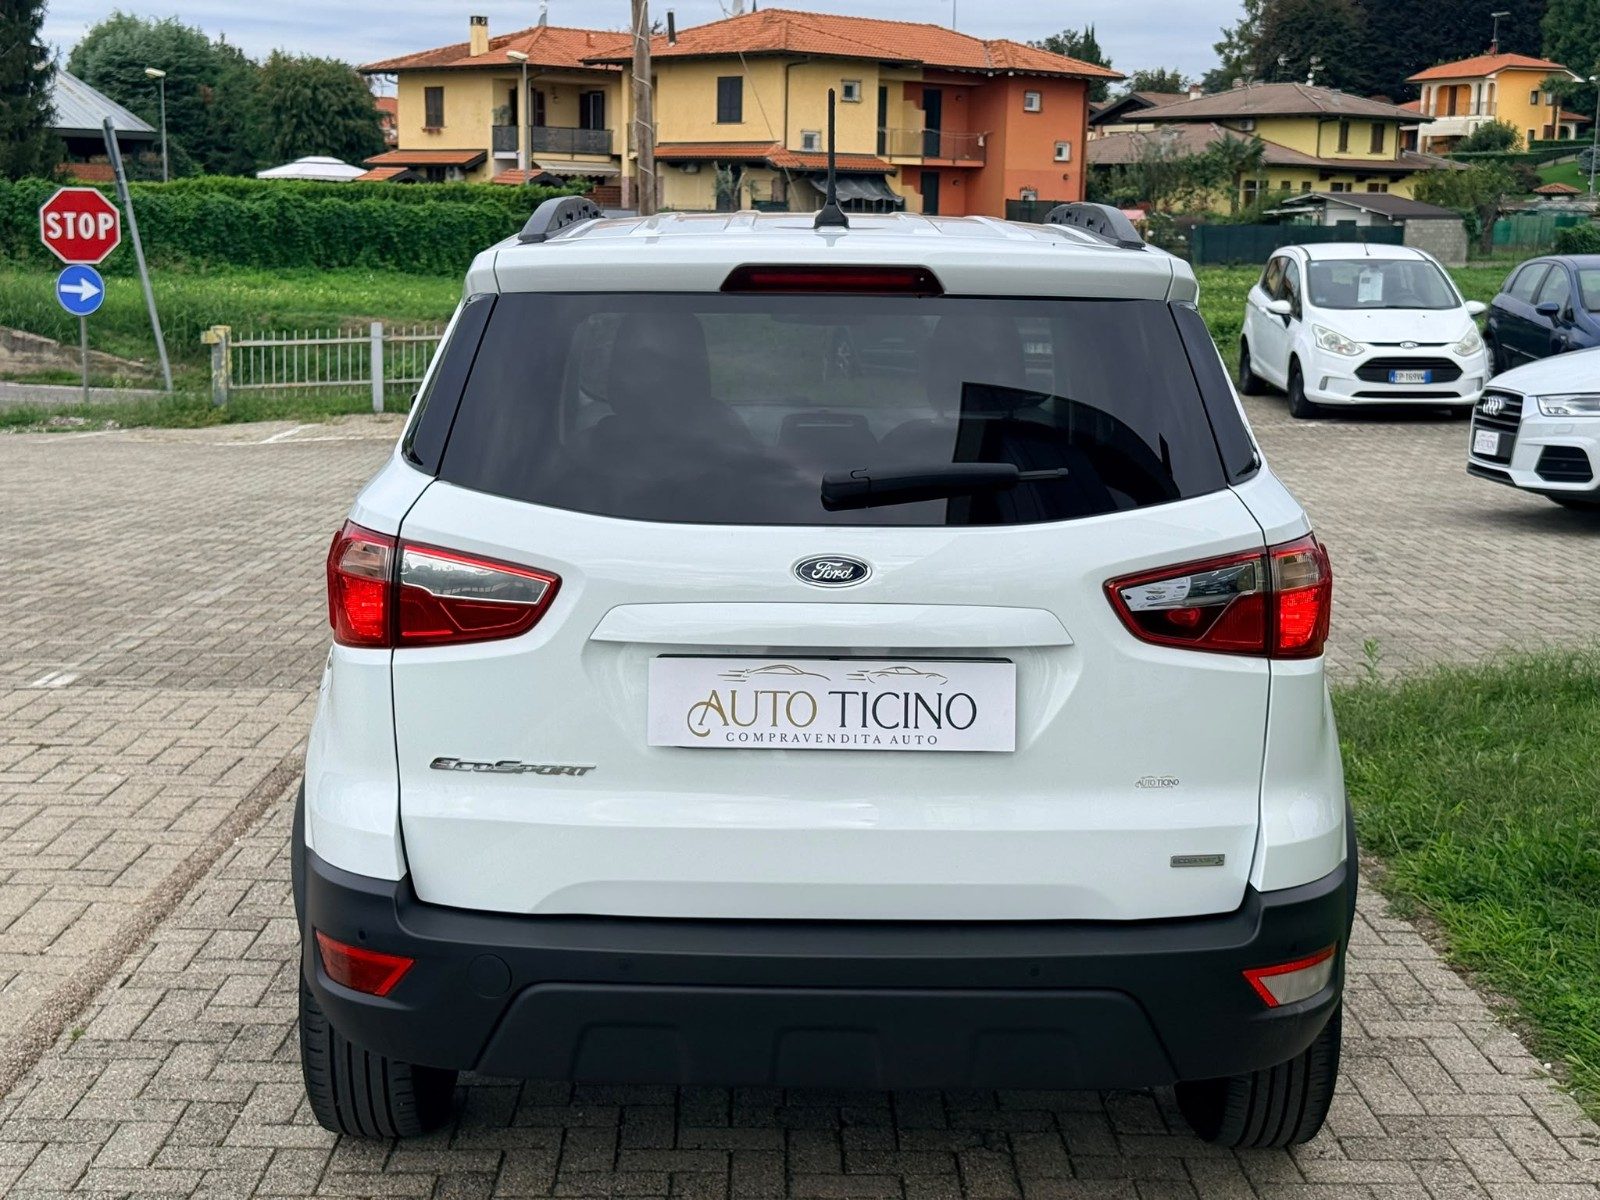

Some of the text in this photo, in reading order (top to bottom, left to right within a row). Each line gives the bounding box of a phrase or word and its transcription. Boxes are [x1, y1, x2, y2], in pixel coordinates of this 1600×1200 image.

[46, 211, 115, 240] STOP
[811, 561, 854, 579] Ford
[687, 689, 977, 738] AUTO TICINO
[725, 731, 938, 746] COMPRAVENDITA AUTO
